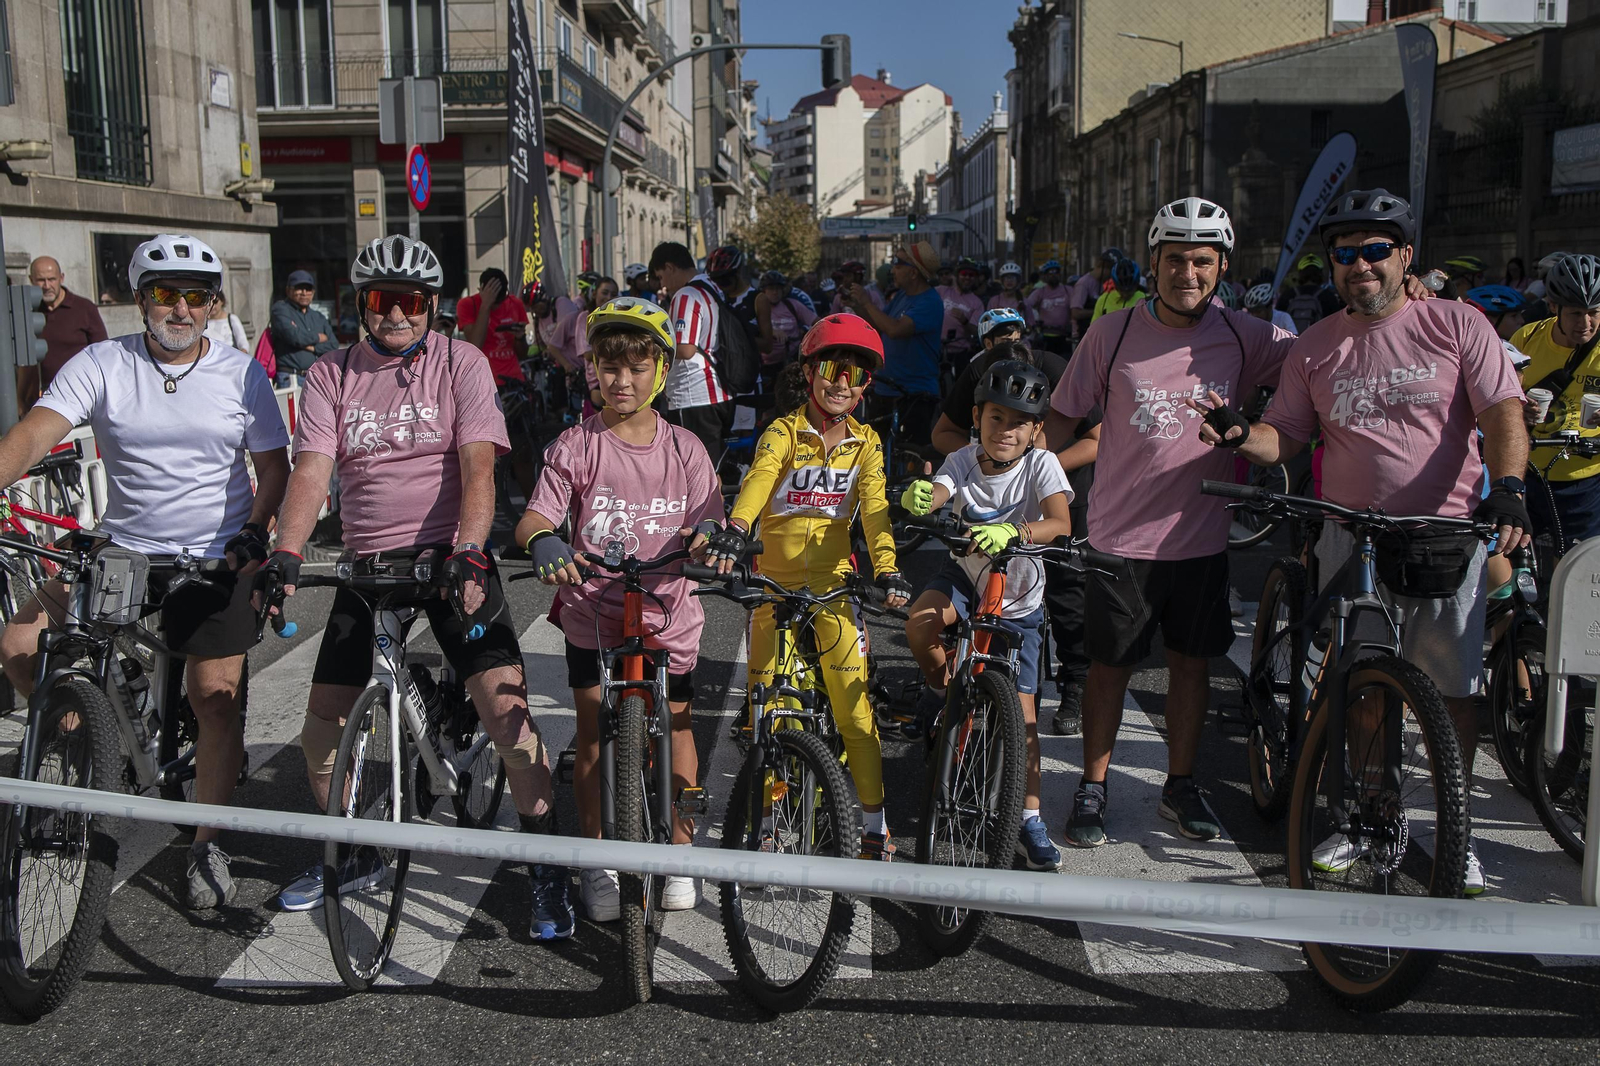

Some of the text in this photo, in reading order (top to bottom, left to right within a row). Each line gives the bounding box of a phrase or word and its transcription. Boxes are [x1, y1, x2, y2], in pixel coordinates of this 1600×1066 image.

[441, 73, 490, 88] ENTRO
[1284, 226, 1305, 255] La
[1332, 376, 1365, 394] Día
[1390, 362, 1437, 384] Bici
[1134, 386, 1168, 402] Día
[1170, 391, 1182, 399] de
[1191, 380, 1230, 399] Bici
[344, 406, 376, 423] Día
[399, 402, 439, 420] Bici
[408, 431, 442, 440] DPORTE
[791, 469, 850, 493] UAE
[591, 495, 627, 510] Día
[649, 494, 687, 514] Bci
[790, 492, 844, 506] Emirates
